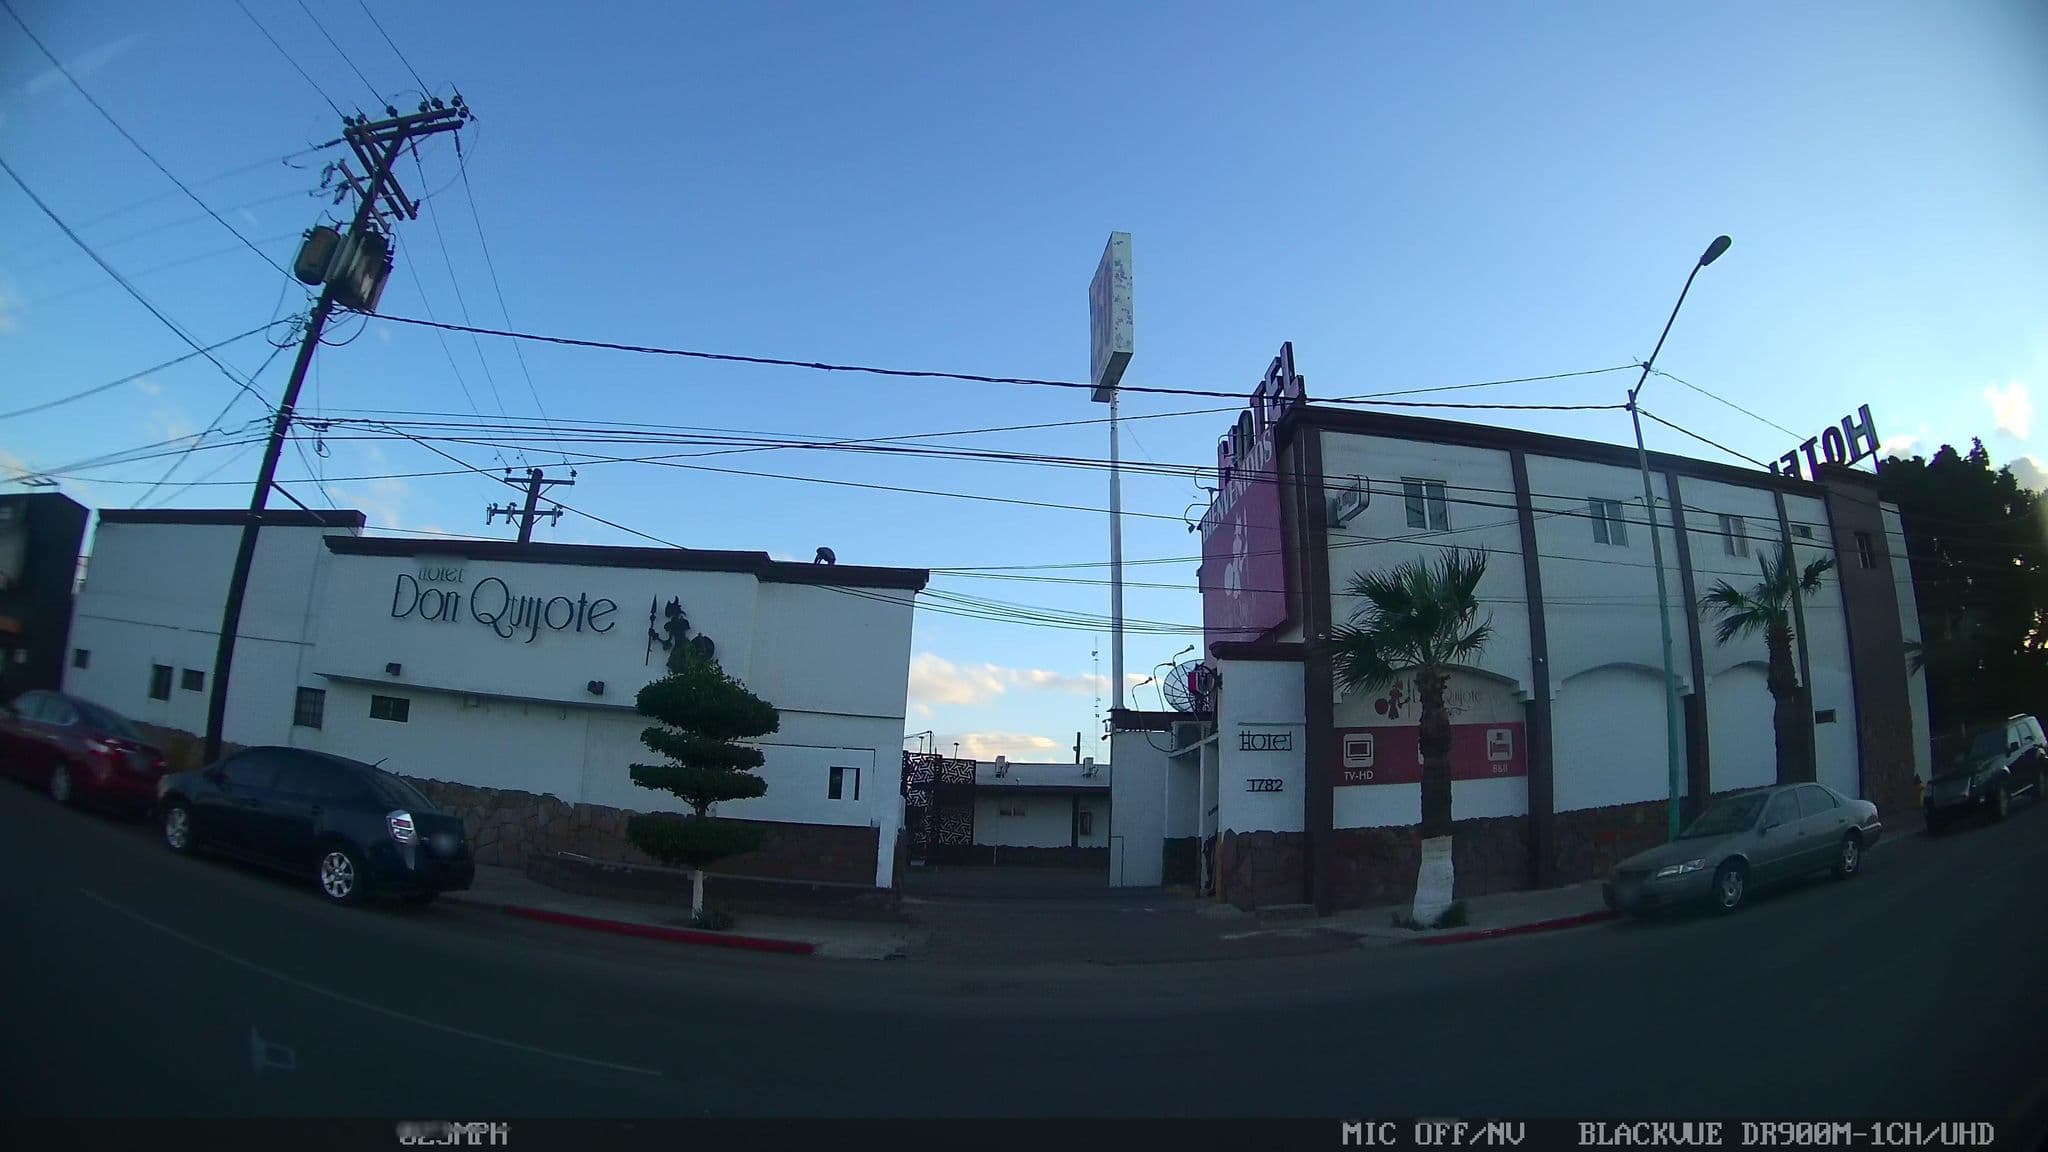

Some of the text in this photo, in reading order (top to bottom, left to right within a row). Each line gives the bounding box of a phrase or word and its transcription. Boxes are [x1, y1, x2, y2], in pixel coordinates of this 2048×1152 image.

[1217, 341, 1305, 489] HOTEL
[391, 574, 618, 644] Don Quijote
[1239, 730, 1292, 751] Hotel
[1246, 778, 1283, 793] 1782
[1344, 770, 1374, 781] TV-HD
